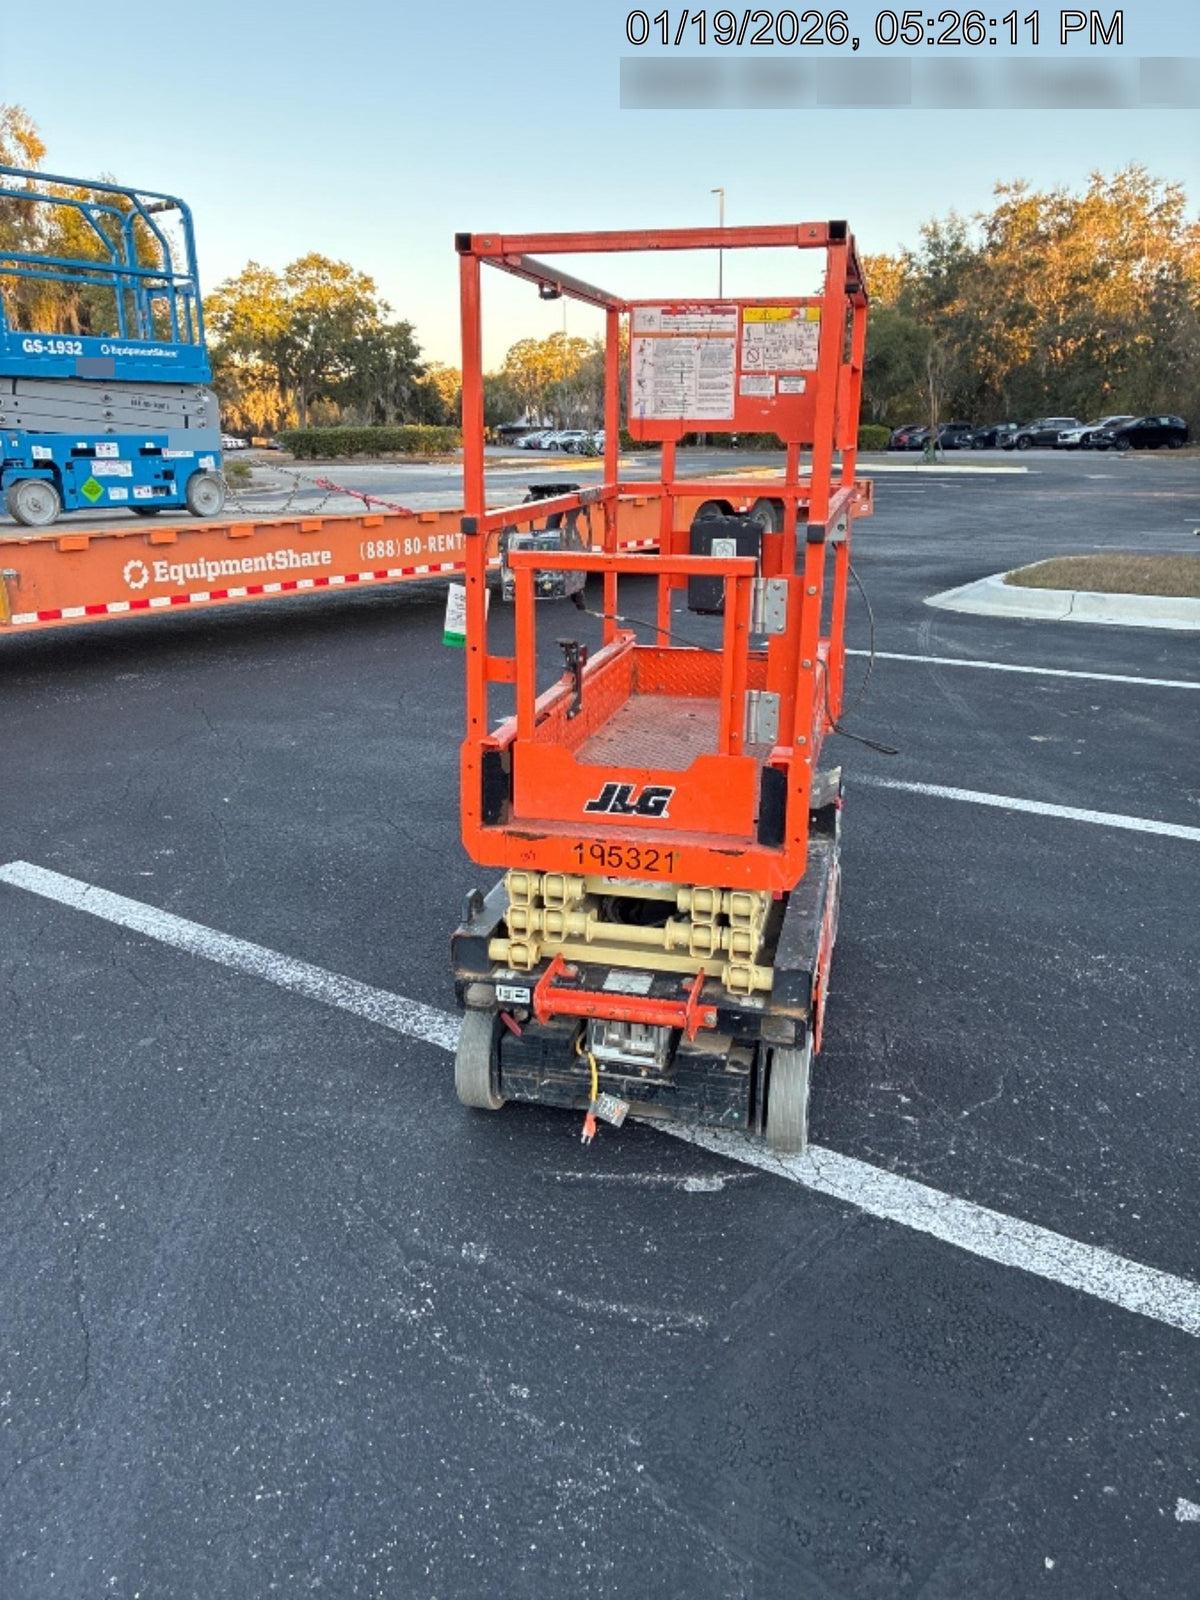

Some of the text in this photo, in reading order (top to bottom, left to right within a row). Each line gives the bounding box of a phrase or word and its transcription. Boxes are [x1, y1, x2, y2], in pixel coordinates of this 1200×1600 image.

[22, 338, 84, 356] GS-1932
[360, 532, 467, 561] (888) 80-RENT
[152, 549, 332, 586] EquipmentShare
[583, 781, 676, 818] JLG
[573, 842, 676, 874] 195321
